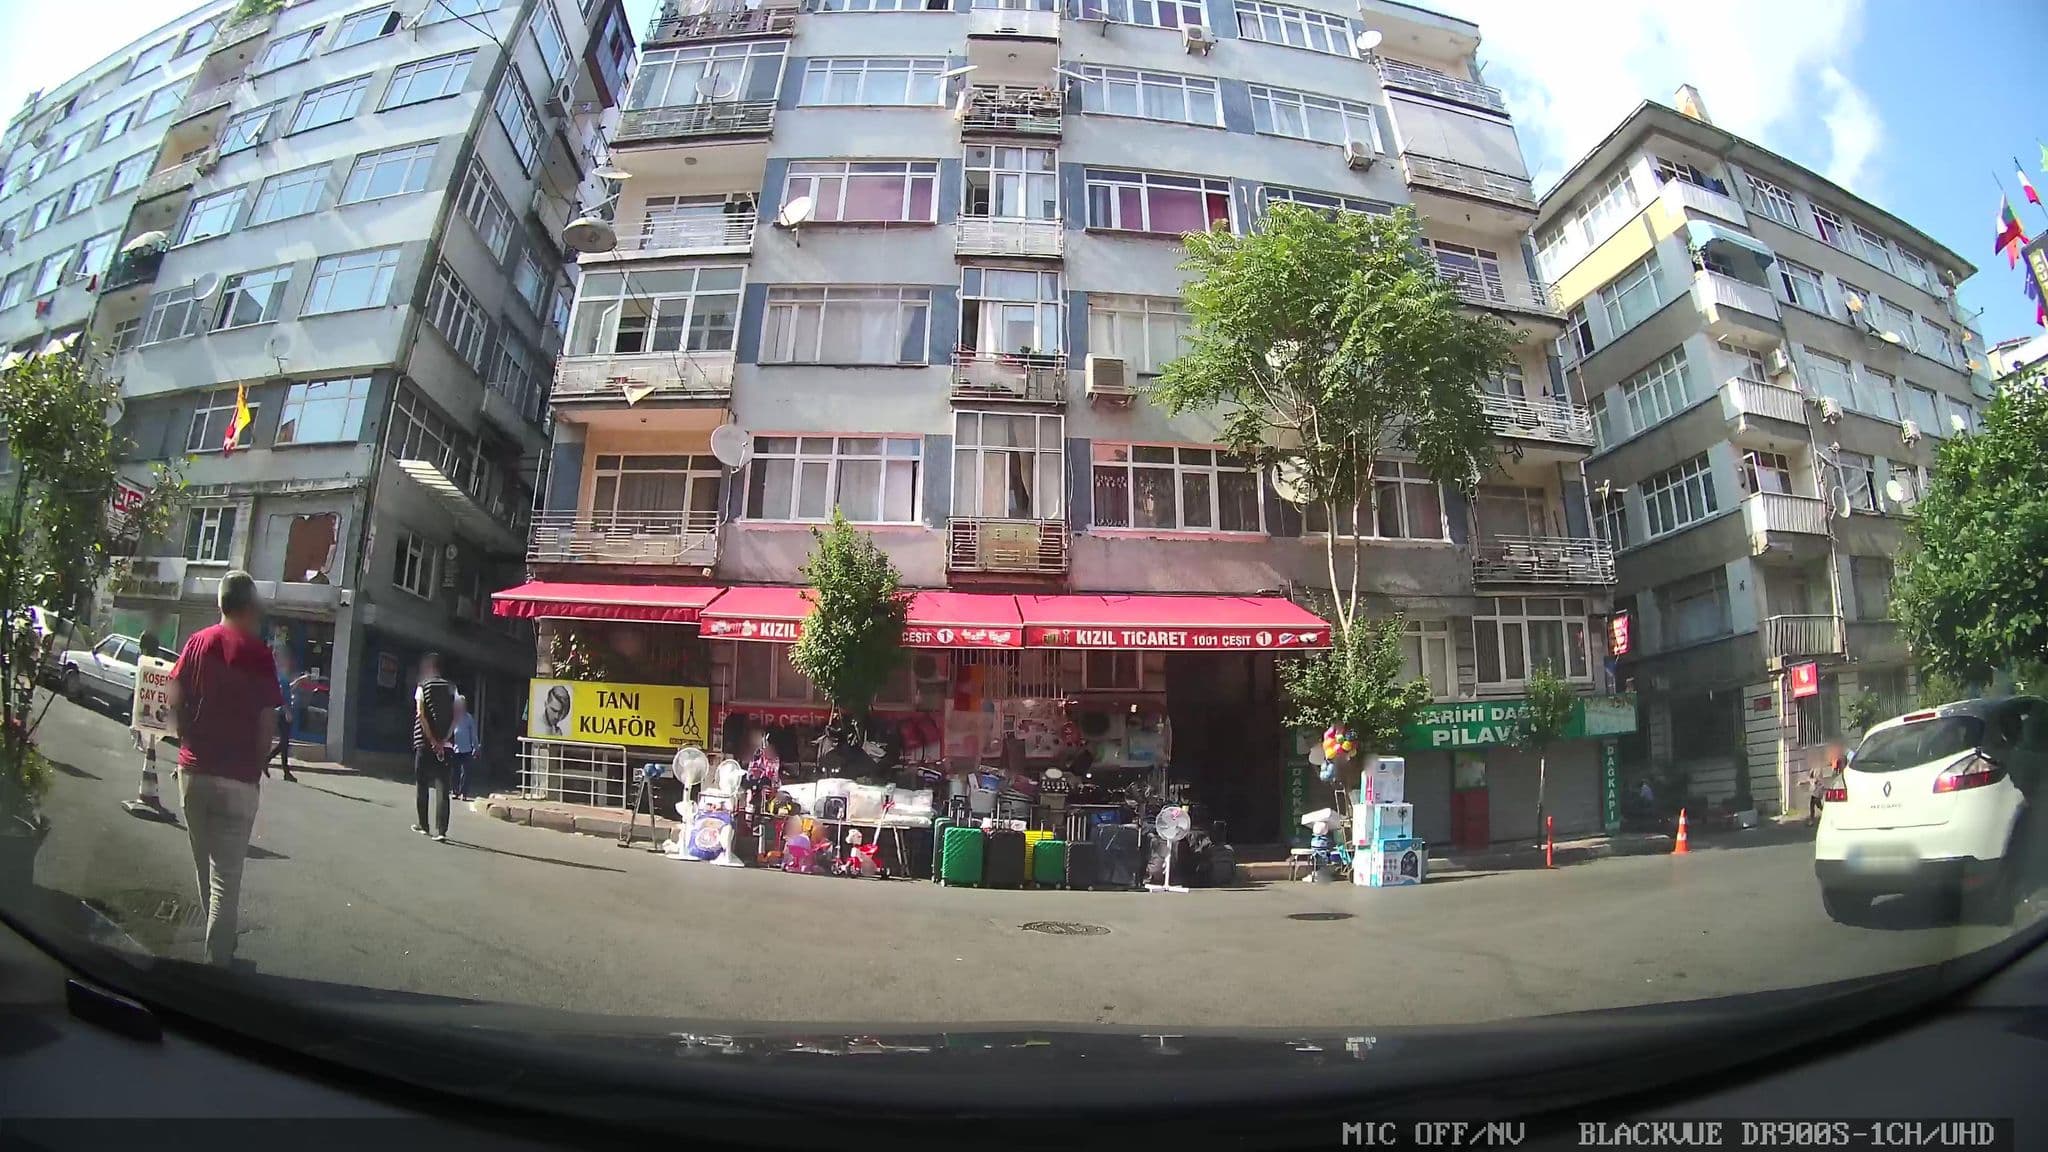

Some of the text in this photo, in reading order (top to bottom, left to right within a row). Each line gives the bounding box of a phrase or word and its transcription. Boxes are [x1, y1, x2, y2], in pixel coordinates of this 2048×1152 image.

[760, 622, 798, 637] KIZIL
[1075, 630, 1117, 645] KIZIL
[1192, 635, 1218, 646] 1001
[596, 690, 640, 711] TANI
[579, 715, 657, 738] KUAFÖR
